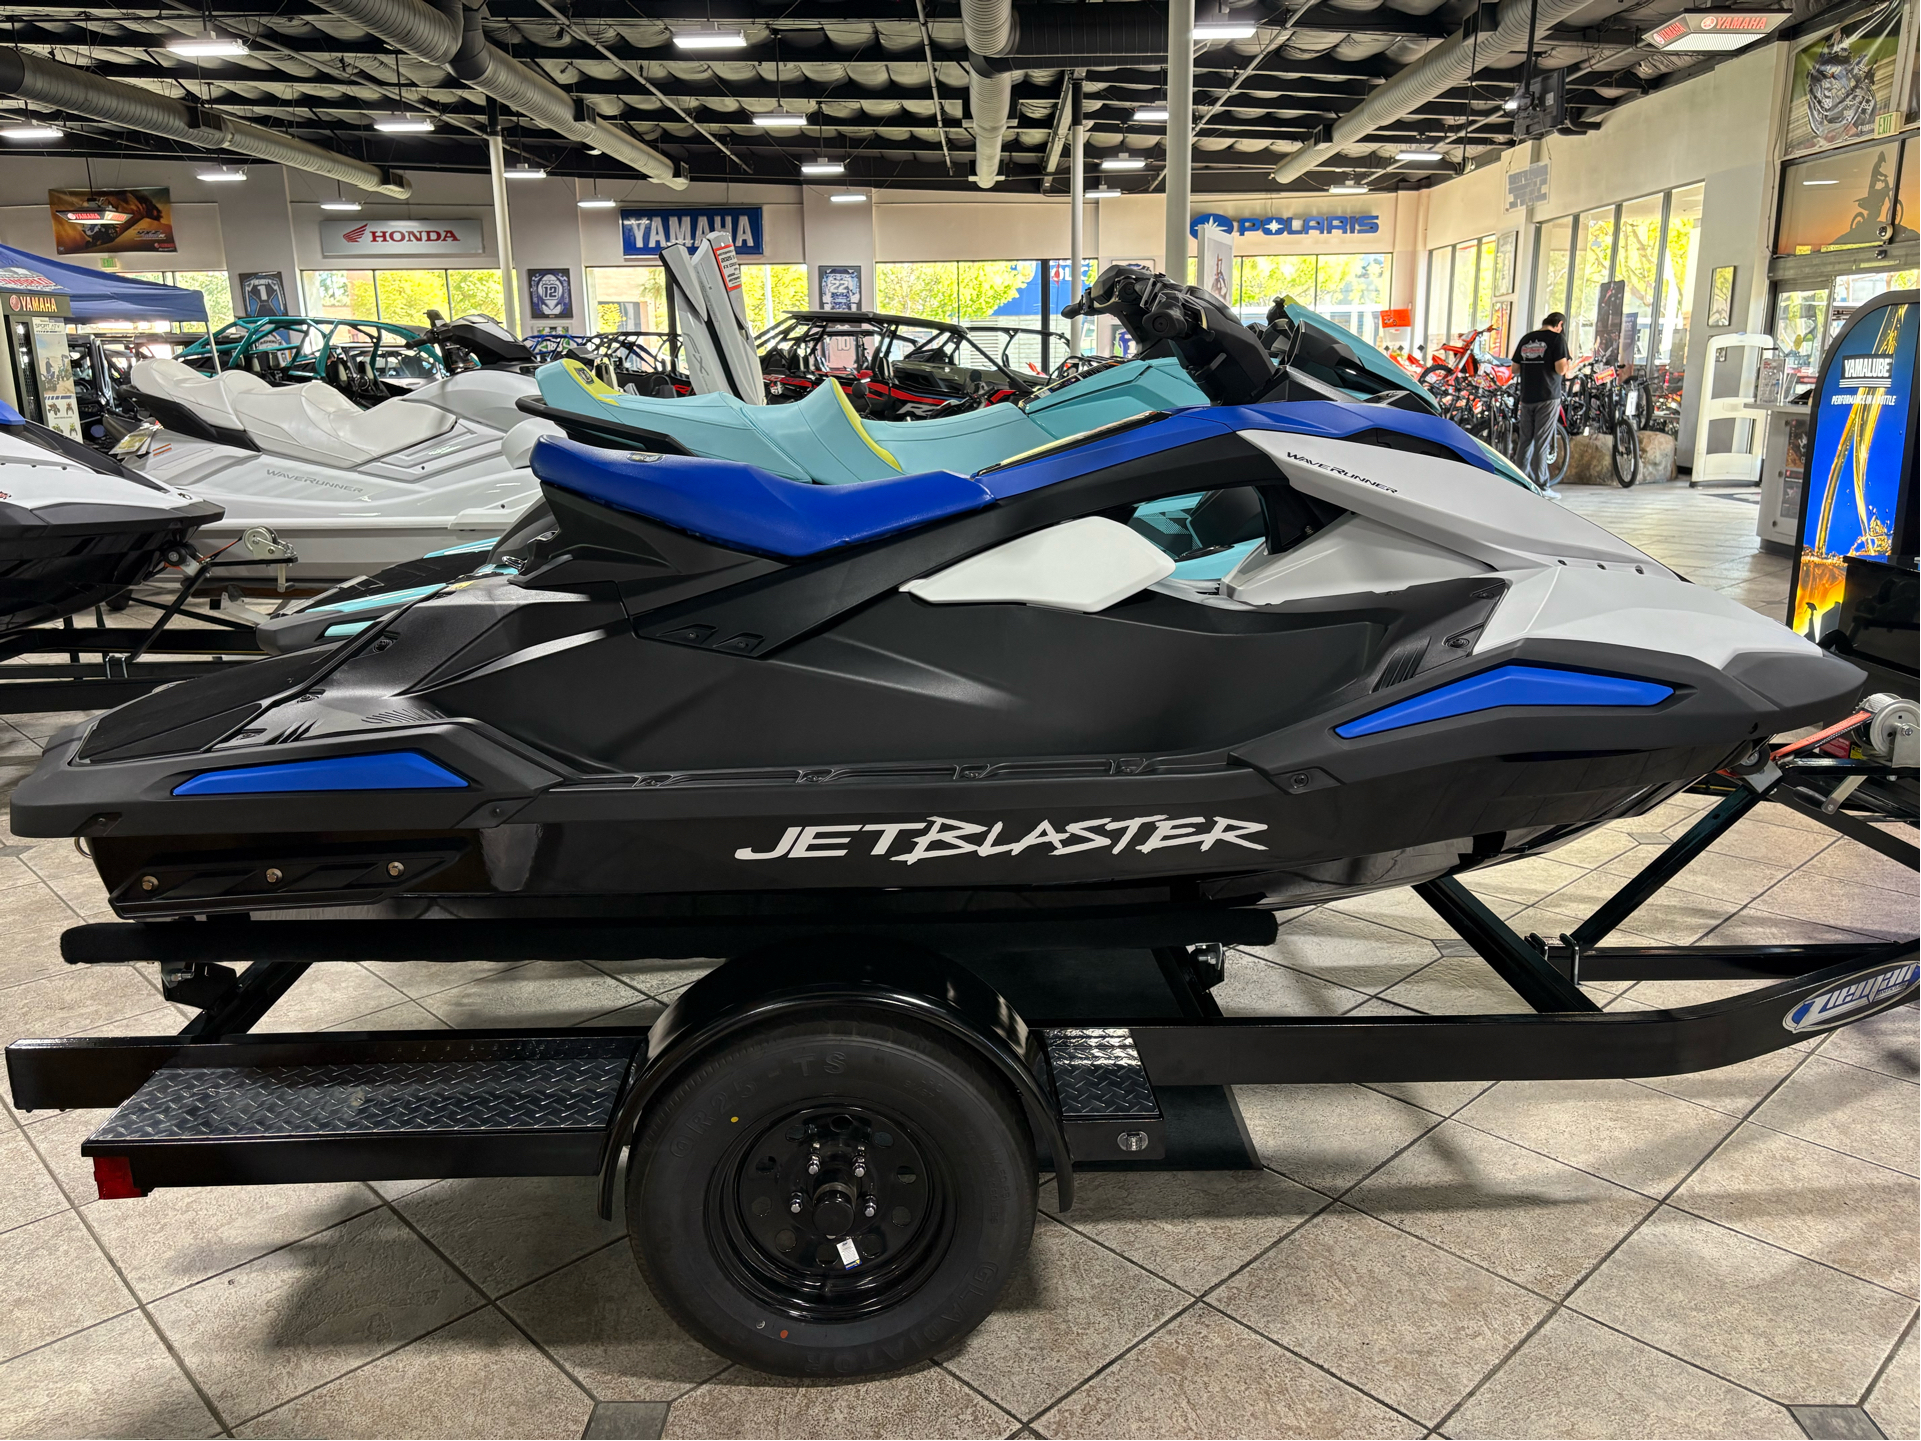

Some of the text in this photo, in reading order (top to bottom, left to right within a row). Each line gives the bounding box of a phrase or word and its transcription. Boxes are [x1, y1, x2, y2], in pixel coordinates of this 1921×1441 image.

[1716, 16, 1768, 30] YAMAHA
[1877, 113, 1894, 135] EXIT
[628, 215, 755, 249] YAMAHA
[1239, 214, 1380, 237] POLARIS
[369, 230, 461, 243] HONDA
[542, 285, 558, 299] 12
[829, 280, 848, 293] 22
[20, 296, 58, 312] YAMAHA
[835, 336, 851, 351] 10
[1844, 358, 1891, 378] YAMALUBE
[266, 469, 364, 493] WAVERUNNER
[1286, 451, 1398, 494] WAVERUNNER
[735, 815, 1269, 865] JETBLASTER
[803, 1261, 999, 1374] GLADIATOR
